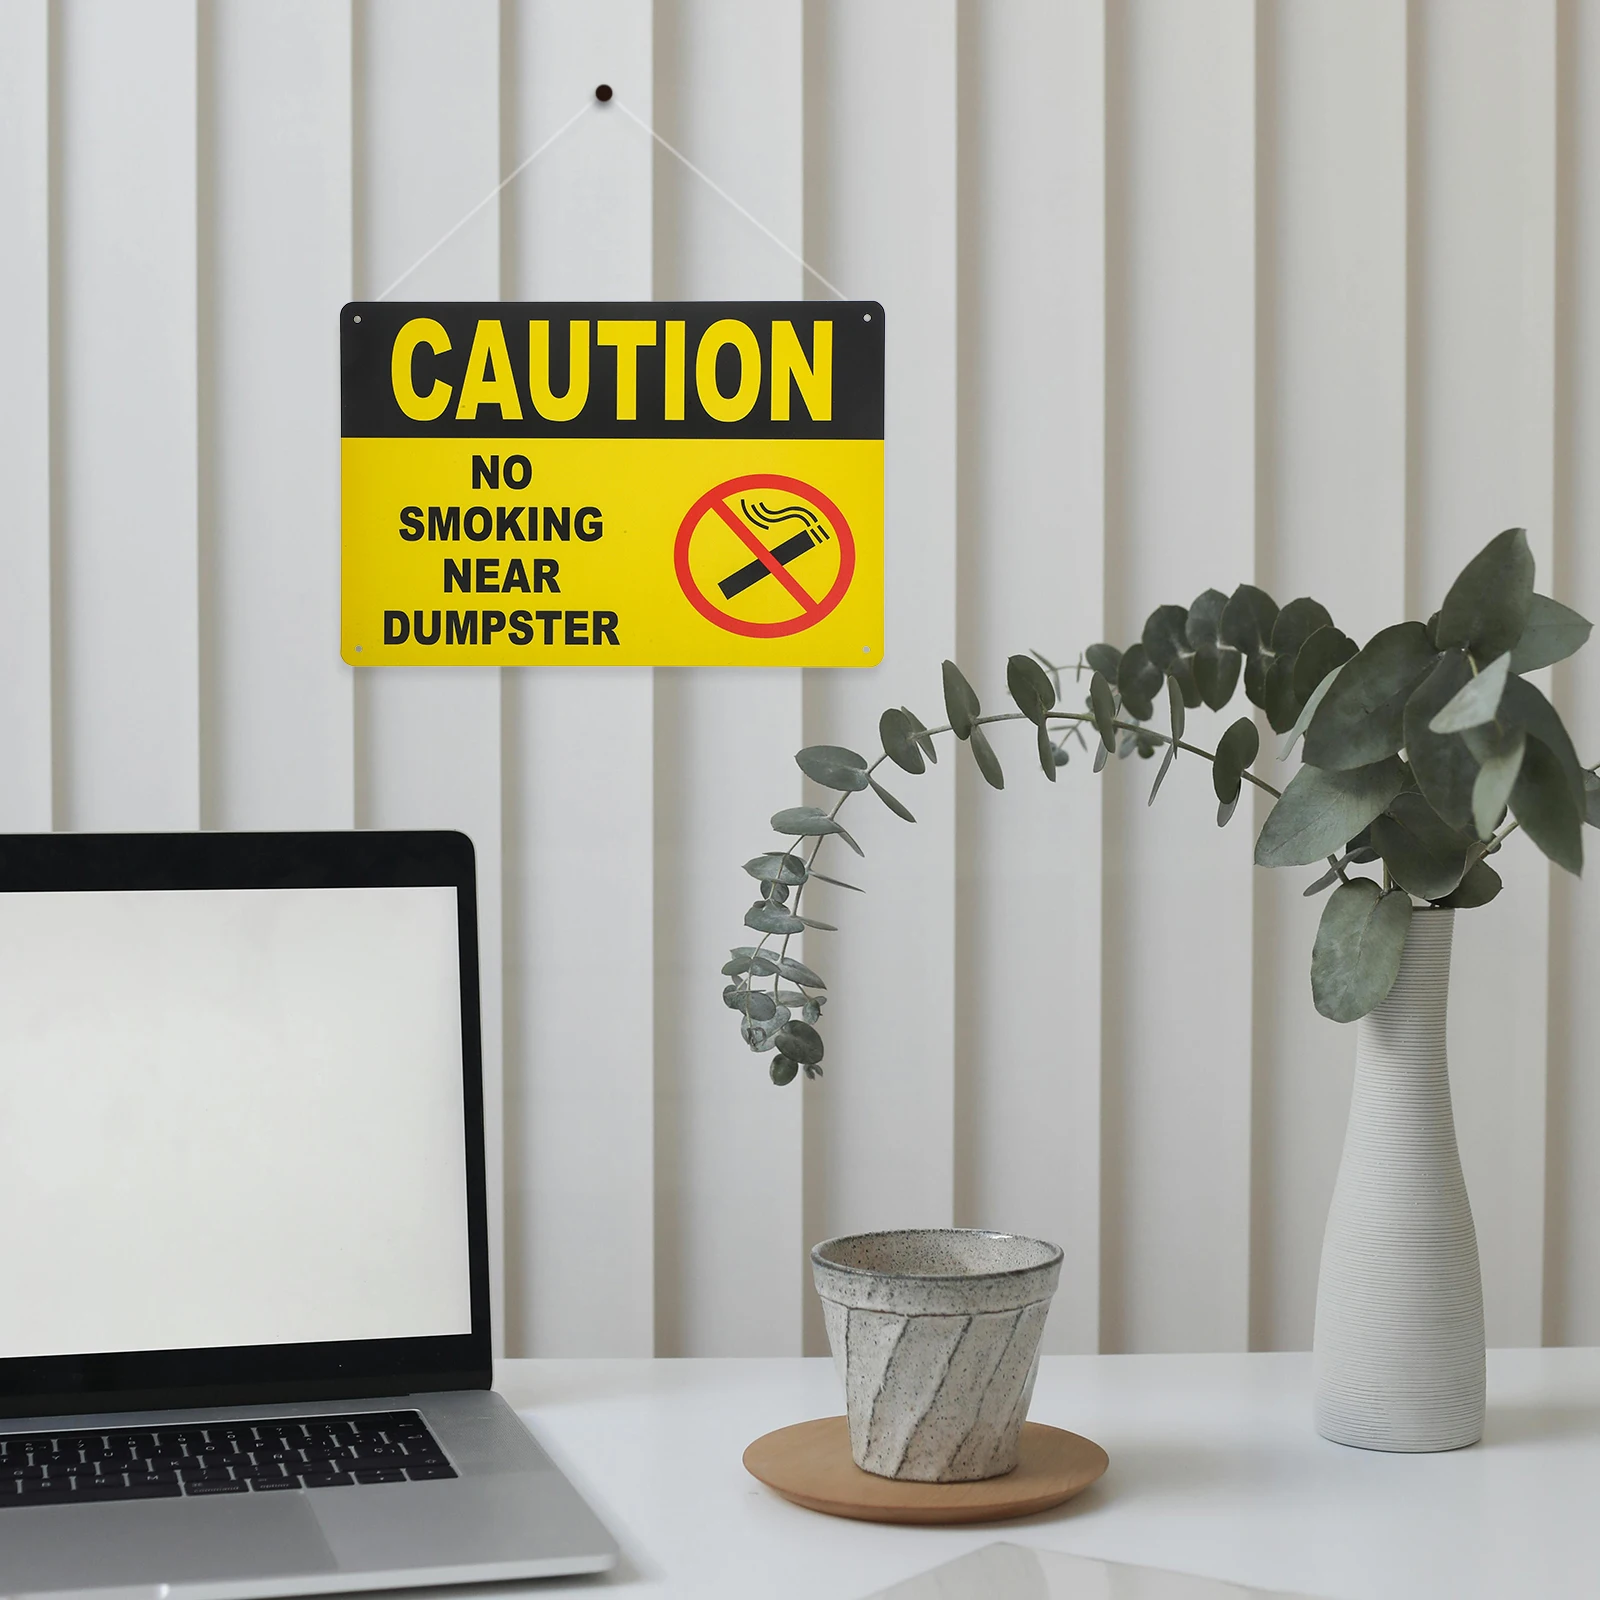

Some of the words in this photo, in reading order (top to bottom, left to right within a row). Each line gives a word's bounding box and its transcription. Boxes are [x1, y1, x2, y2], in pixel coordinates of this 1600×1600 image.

[392, 318, 832, 422] CAUTION
[472, 455, 532, 489] NO
[399, 506, 602, 541] SMOKING
[444, 559, 560, 593] NEAR
[384, 610, 620, 645] DUMPSTER
